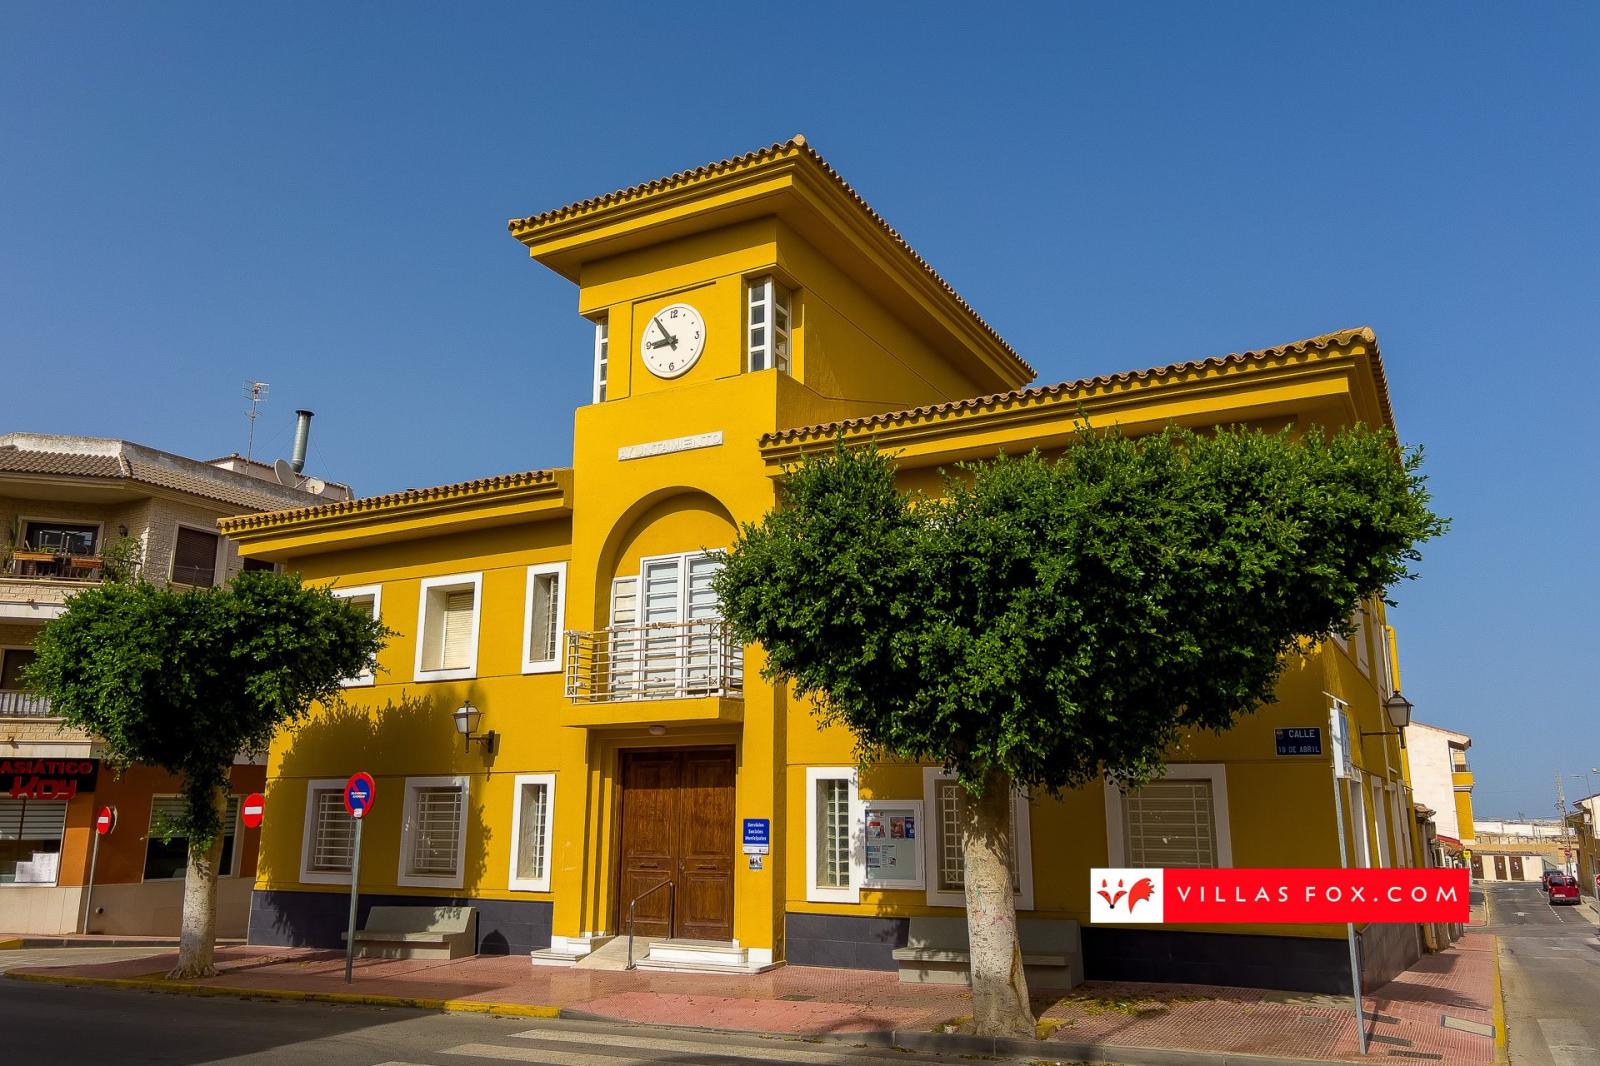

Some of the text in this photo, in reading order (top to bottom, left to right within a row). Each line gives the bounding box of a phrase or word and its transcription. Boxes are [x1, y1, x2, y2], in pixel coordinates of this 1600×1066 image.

[670, 310, 678, 318] 12
[694, 331, 700, 340] 3
[646, 341, 652, 350] 9
[668, 362, 674, 371] 6
[1288, 729, 1316, 738] CALLE
[0, 759, 93, 774] ASIÁTICO
